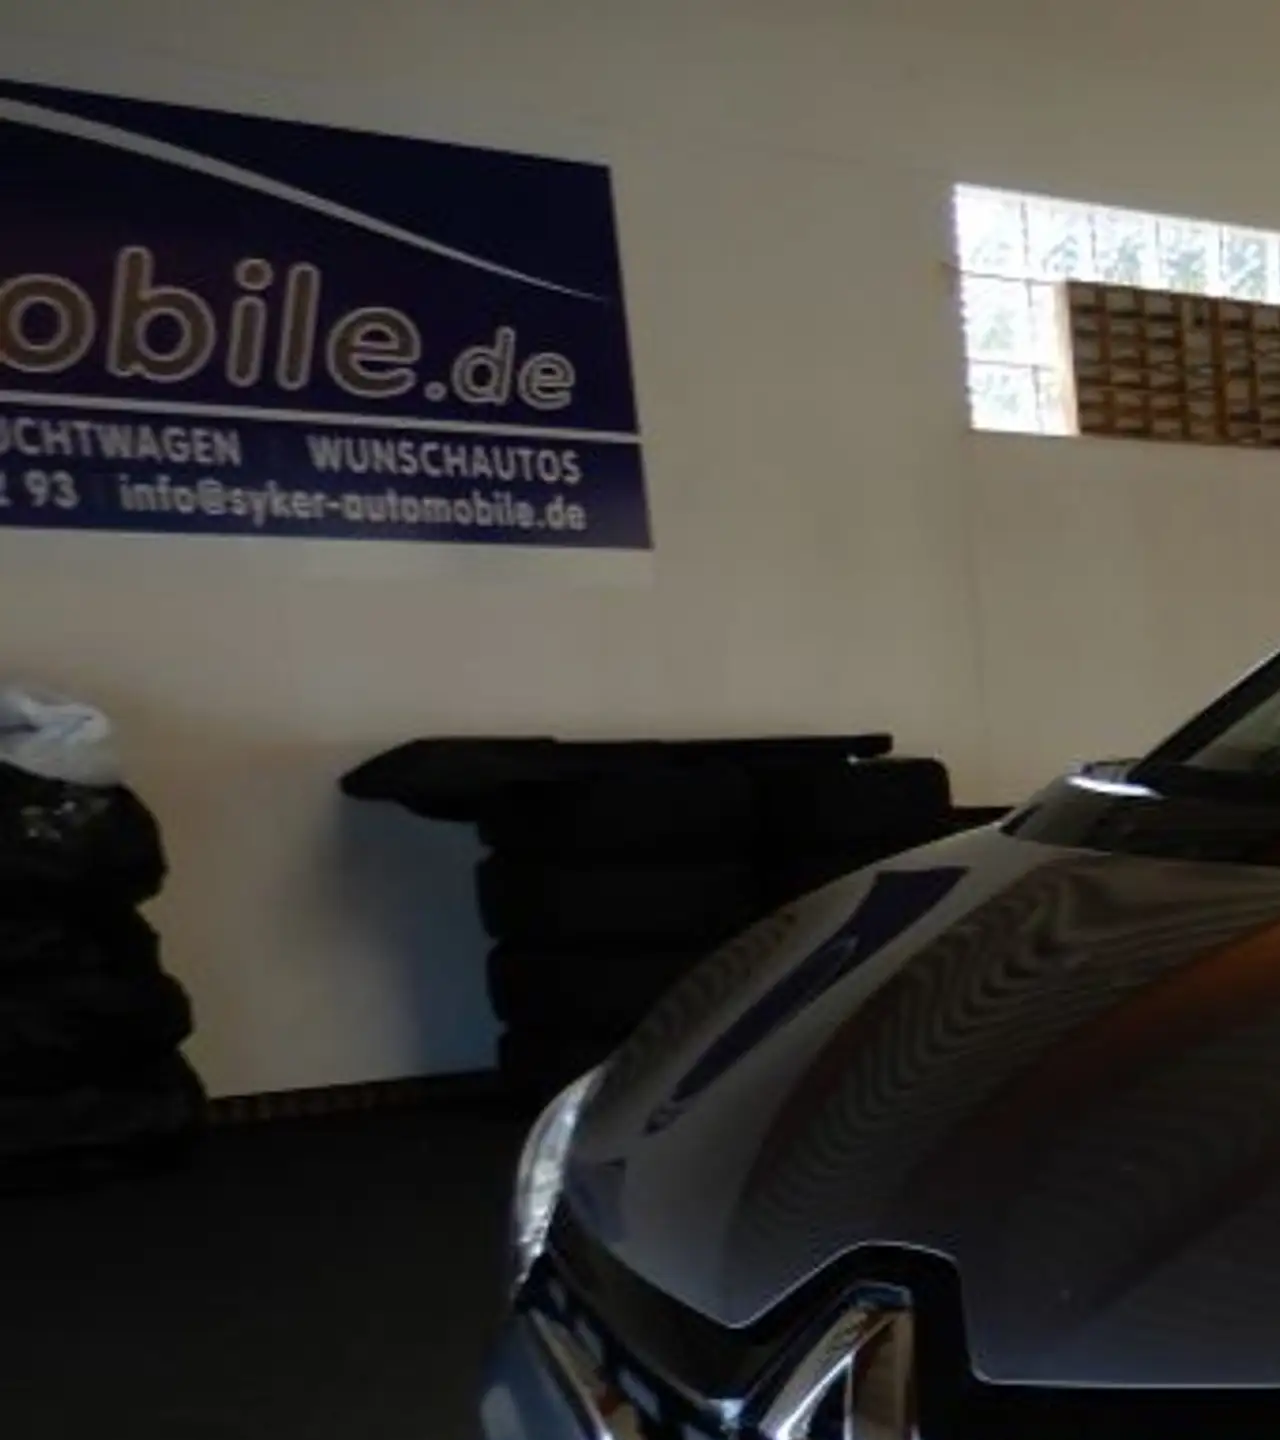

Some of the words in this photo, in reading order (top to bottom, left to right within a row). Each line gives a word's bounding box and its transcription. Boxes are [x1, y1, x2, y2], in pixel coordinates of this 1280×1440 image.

[305, 434, 583, 485] WUNSCHAUTOS
[24, 469, 80, 509] 93
[118, 473, 587, 531] info@syker-automobile.de
